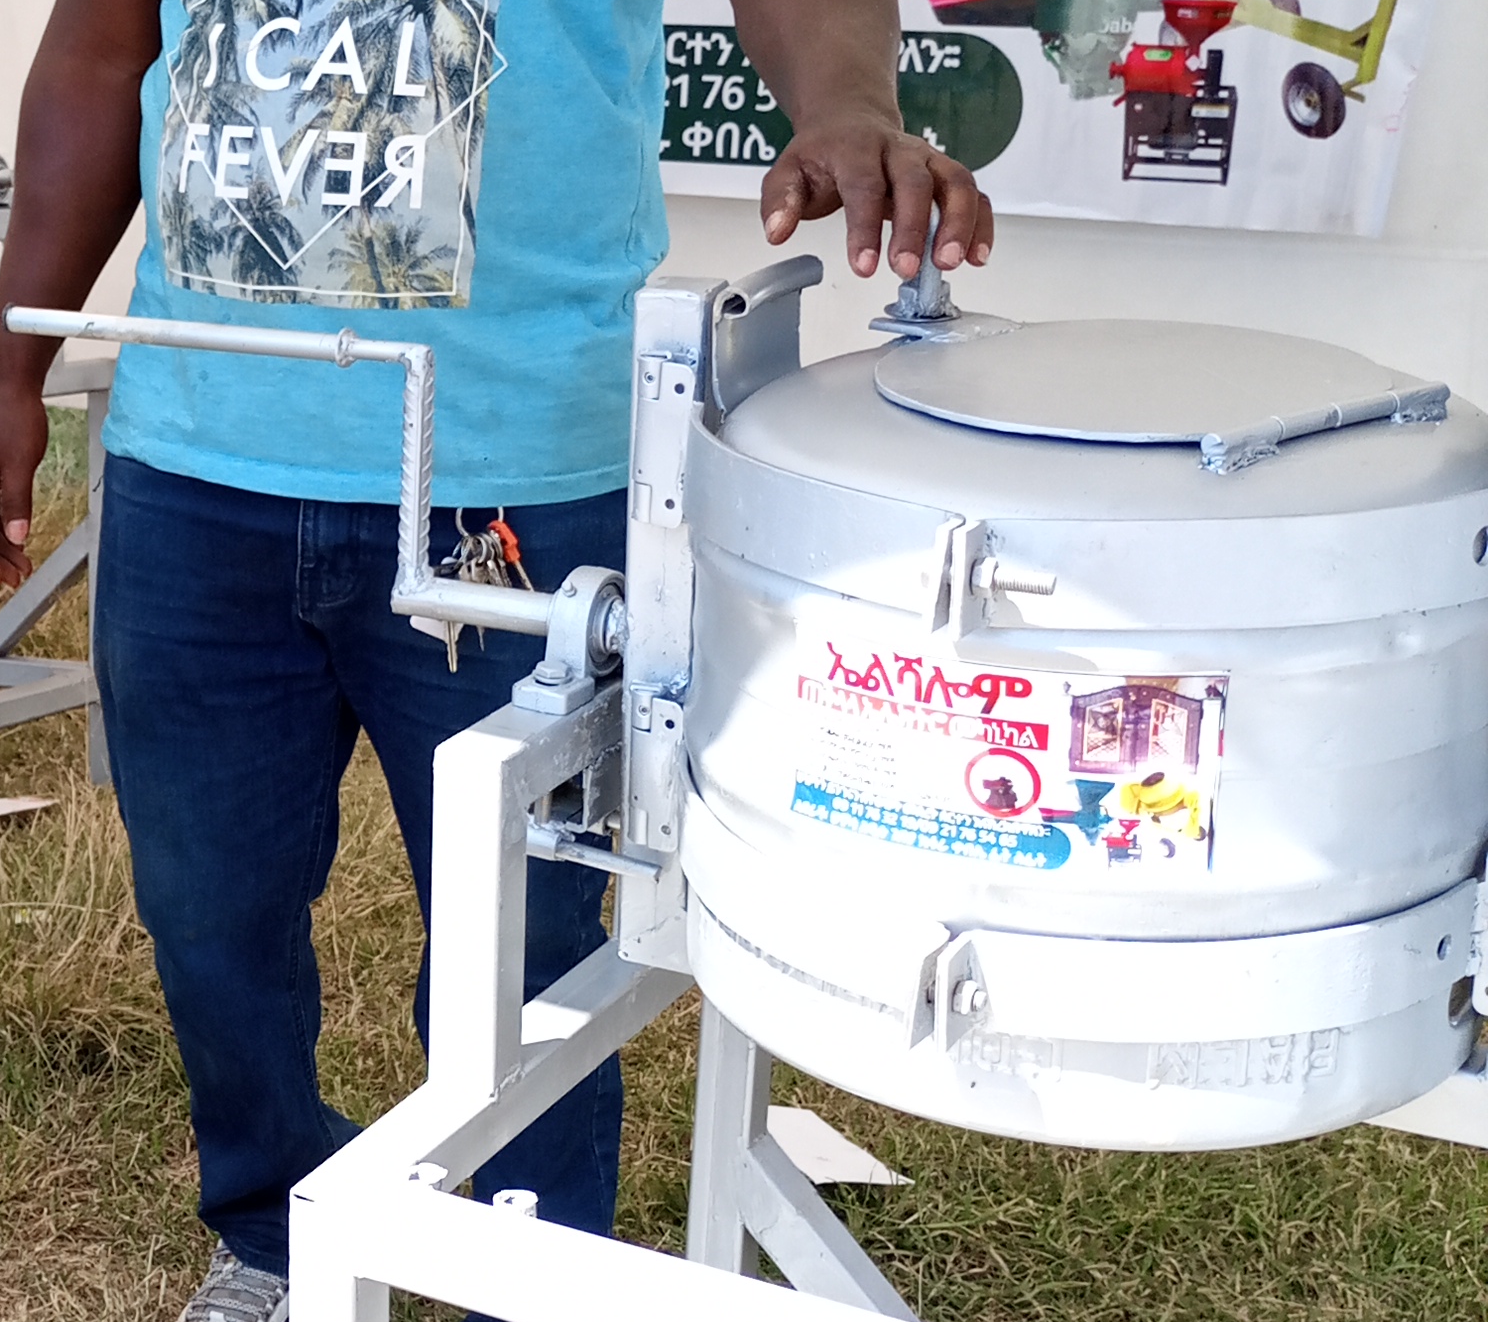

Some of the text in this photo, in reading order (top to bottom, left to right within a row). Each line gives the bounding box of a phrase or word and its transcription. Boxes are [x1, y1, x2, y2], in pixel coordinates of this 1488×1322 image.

[203, 16, 426, 98] ICAL
[701, 74, 746, 111] 76
[177, 122, 427, 210] FEVER
[681, 120, 777, 162] ቀበሌ
